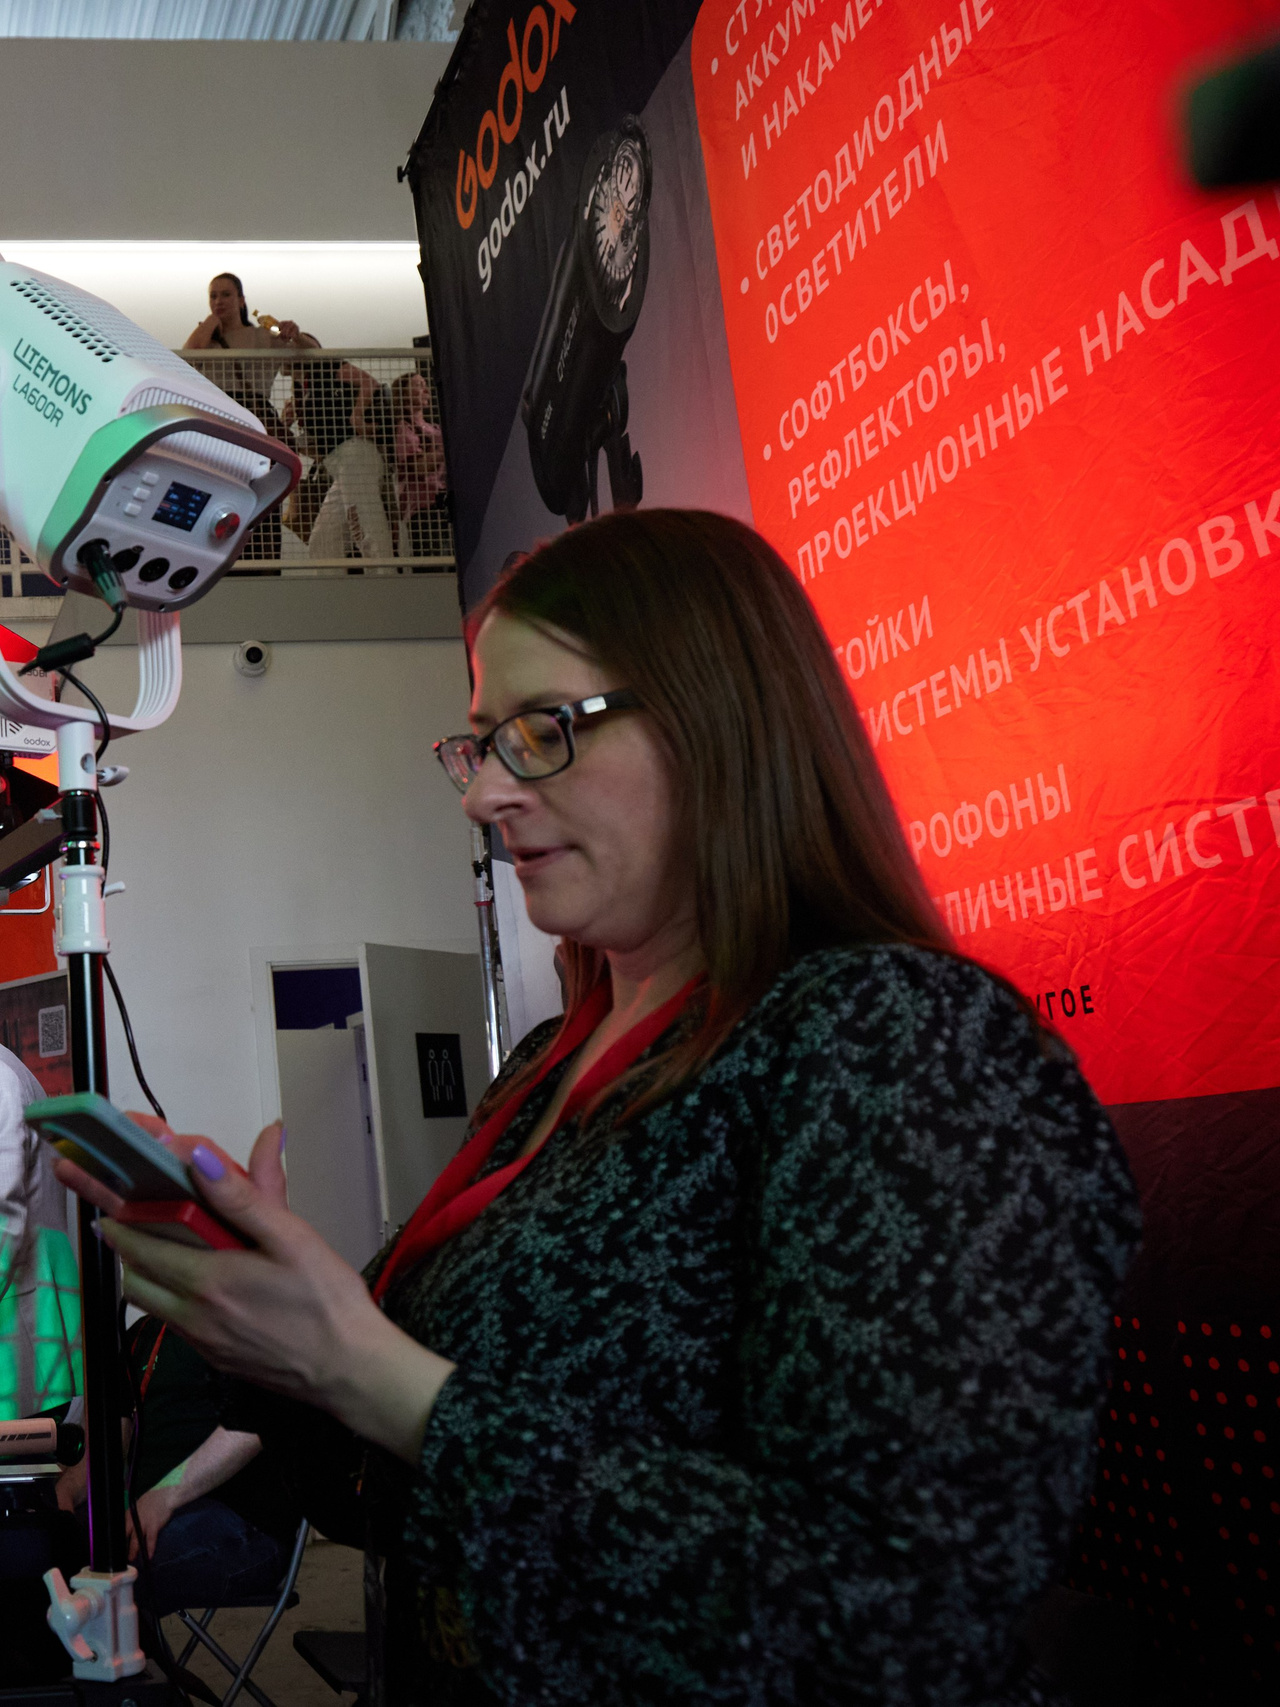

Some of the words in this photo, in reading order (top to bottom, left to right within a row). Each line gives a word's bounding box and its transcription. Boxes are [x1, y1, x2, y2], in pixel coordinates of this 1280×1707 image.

[741, 132, 758, 180] И
[763, 0, 883, 150] НАКАМЕ
[756, 0, 994, 281] СВЕТОДИОДНЫЕ
[477, 85, 570, 293] godox.ru
[765, 119, 949, 343] ОСВЕТИТЕЛИ
[13, 338, 92, 415] LITEMONS
[13, 373, 64, 427] LA600R
[778, 258, 970, 451] СОФТБОКСЫ,
[788, 316, 1007, 519] РЕФЛЕКТОРЫ,
[797, 346, 1069, 586] ПРОЕКЦИОННЫЕ
[1078, 189, 1280, 376] НАСАД
[23, 736, 51, 748] Godox
[860, 637, 1013, 748] ИСТЕМЫ
[934, 847, 1104, 937] ЛИЧНЫЕ
